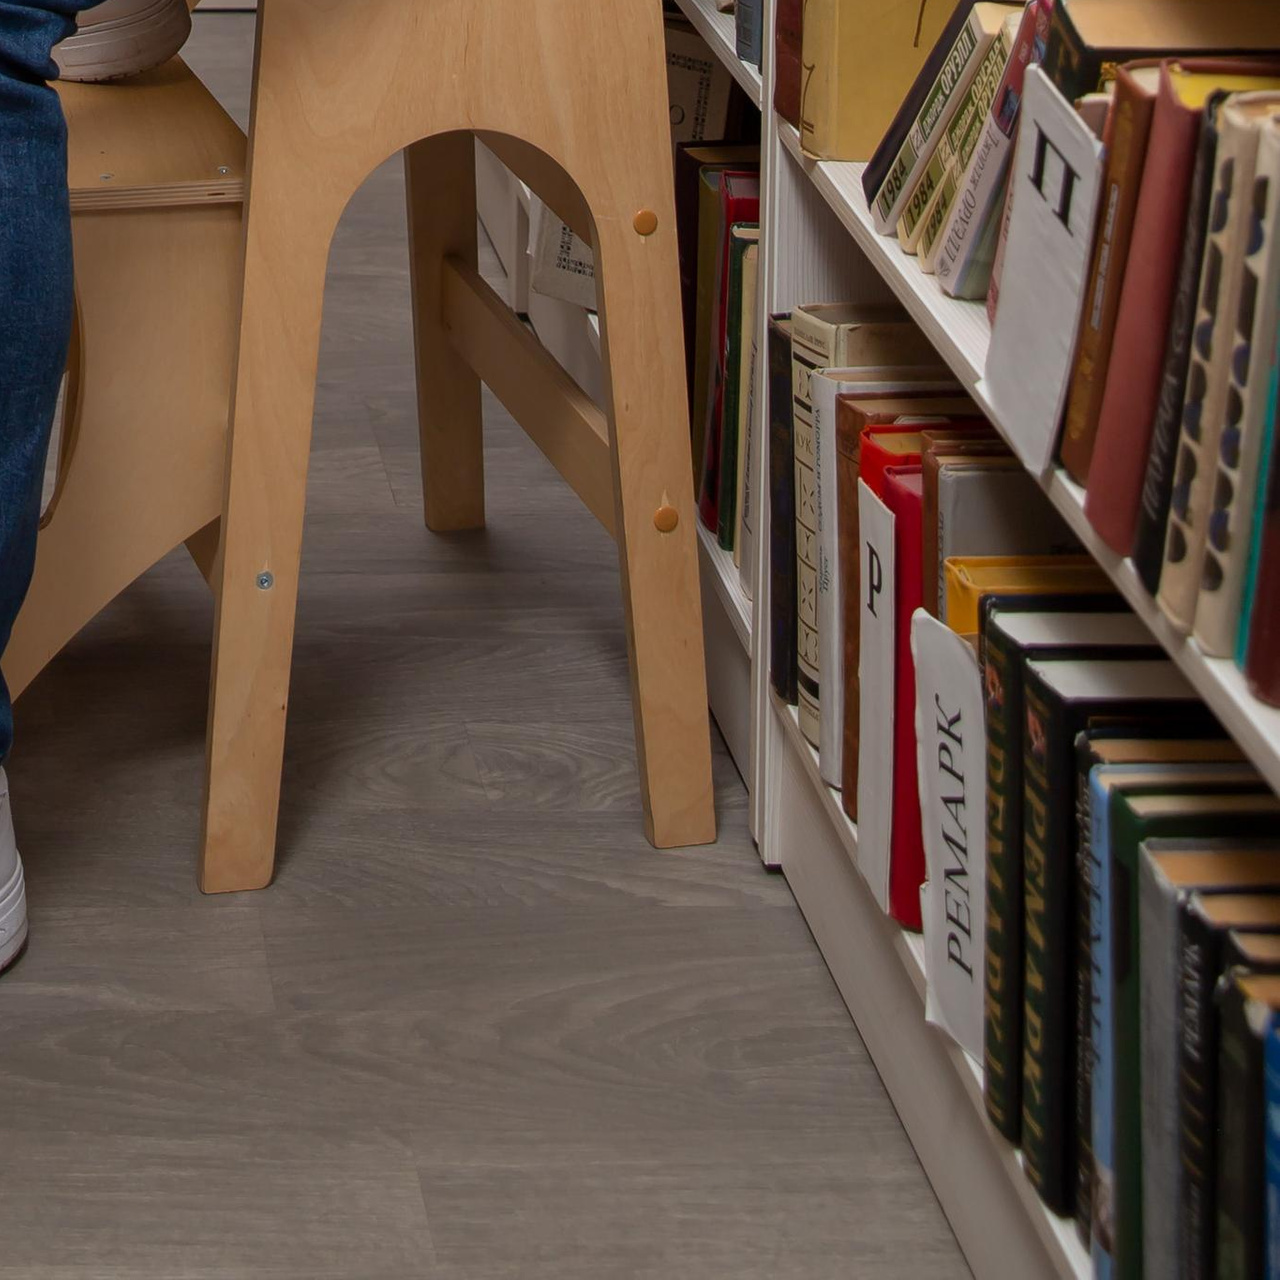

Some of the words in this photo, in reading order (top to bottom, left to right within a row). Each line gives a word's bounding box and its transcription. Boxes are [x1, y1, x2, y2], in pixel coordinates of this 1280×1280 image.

[880, 161, 908, 209] 1984
[940, 31, 976, 99] ОРУЭЛЛ
[970, 127, 1002, 191] Джордж
[906, 174, 935, 225] 1984
[1027, 117, 1081, 237] П
[867, 539, 884, 618] Р
[933, 691, 974, 982] РЕМАРК
